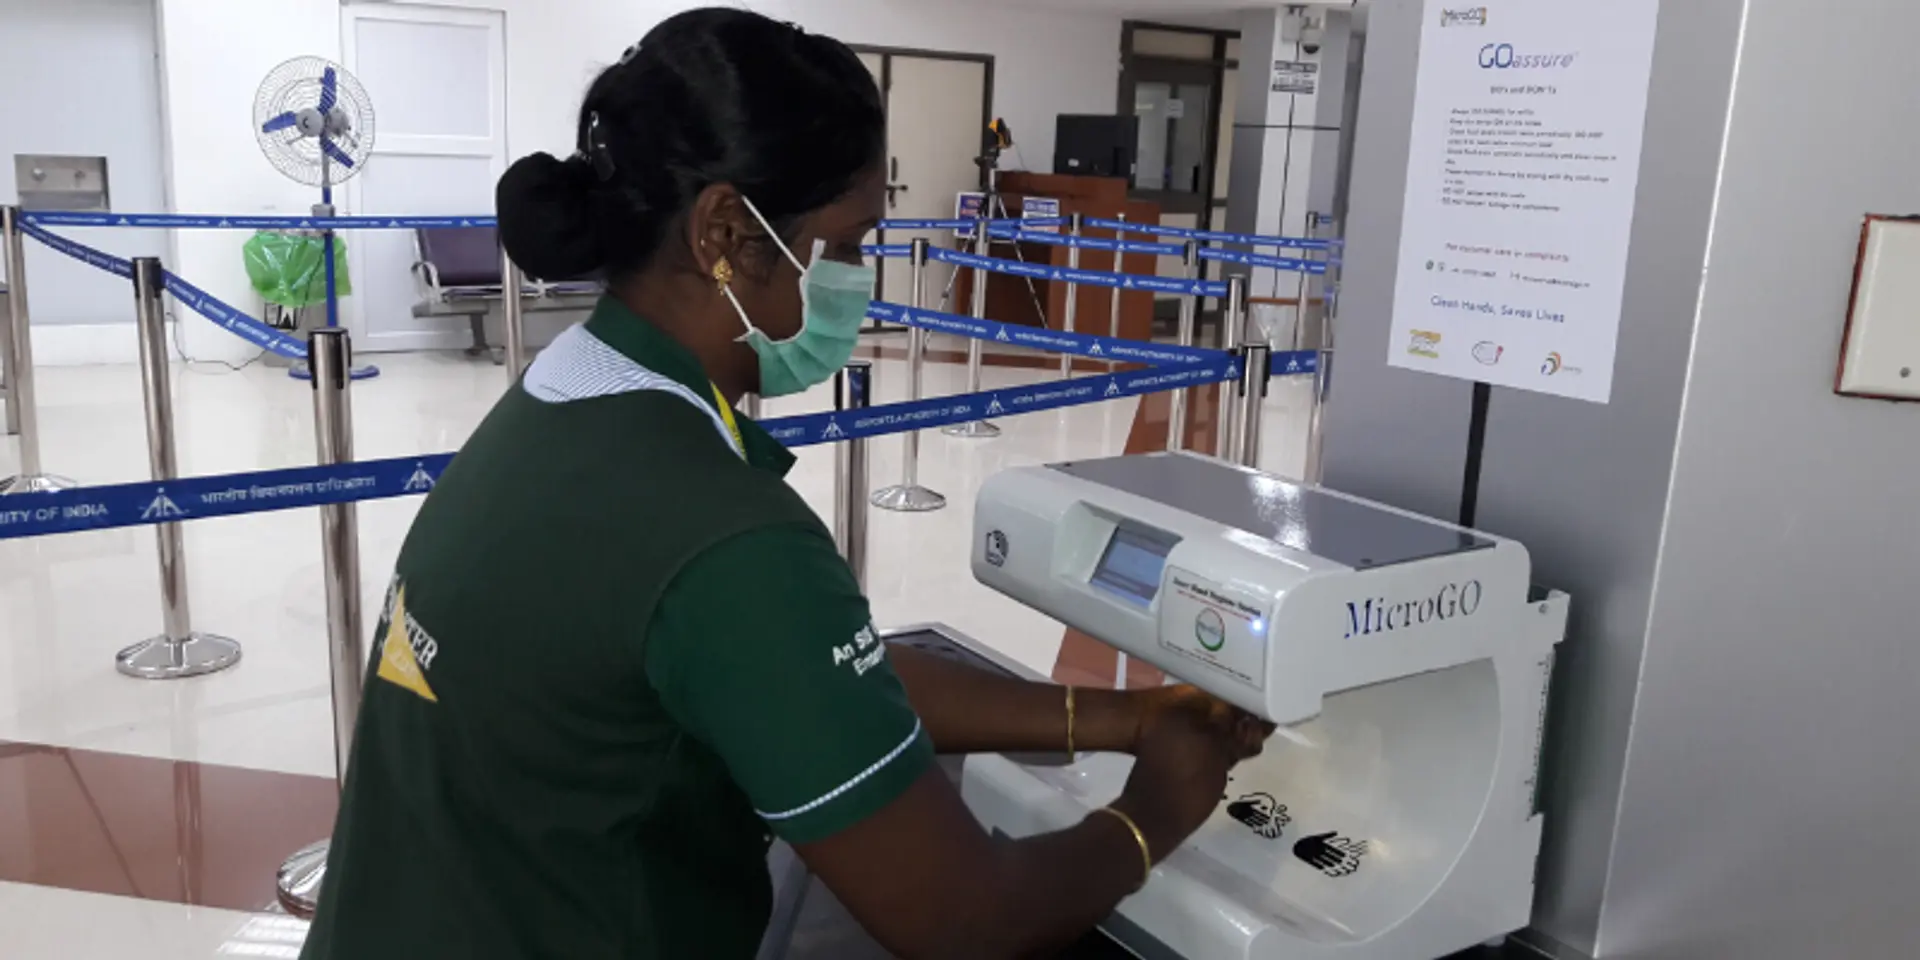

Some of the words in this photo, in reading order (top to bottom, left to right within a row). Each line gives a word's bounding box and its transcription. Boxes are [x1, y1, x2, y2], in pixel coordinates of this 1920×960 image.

[35, 506, 60, 521] OF
[62, 503, 110, 519] INDIA
[1344, 578, 1482, 640] MicroGO
[832, 642, 856, 667] An
